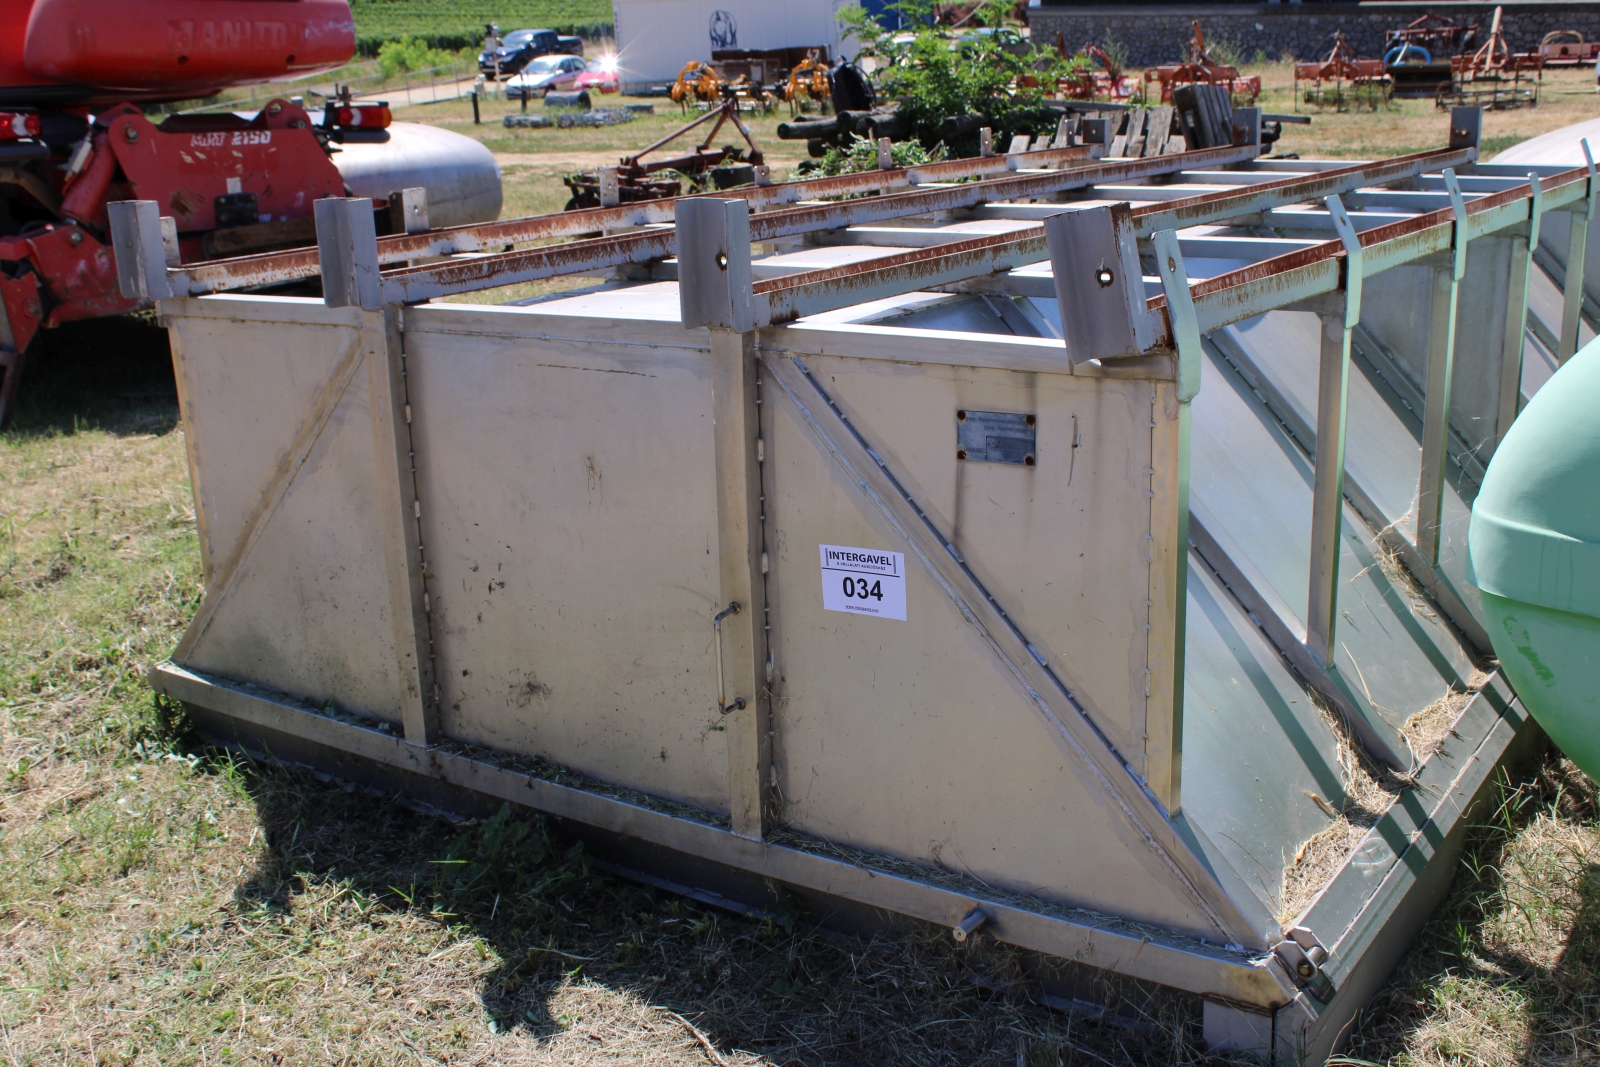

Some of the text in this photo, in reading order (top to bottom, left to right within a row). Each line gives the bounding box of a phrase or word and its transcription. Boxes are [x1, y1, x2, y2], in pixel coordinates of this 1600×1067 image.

[166, 19, 306, 51] MANITOU
[231, 130, 272, 146] 2150
[829, 550, 892, 566] INTERGAVEL
[842, 576, 883, 602] 034
